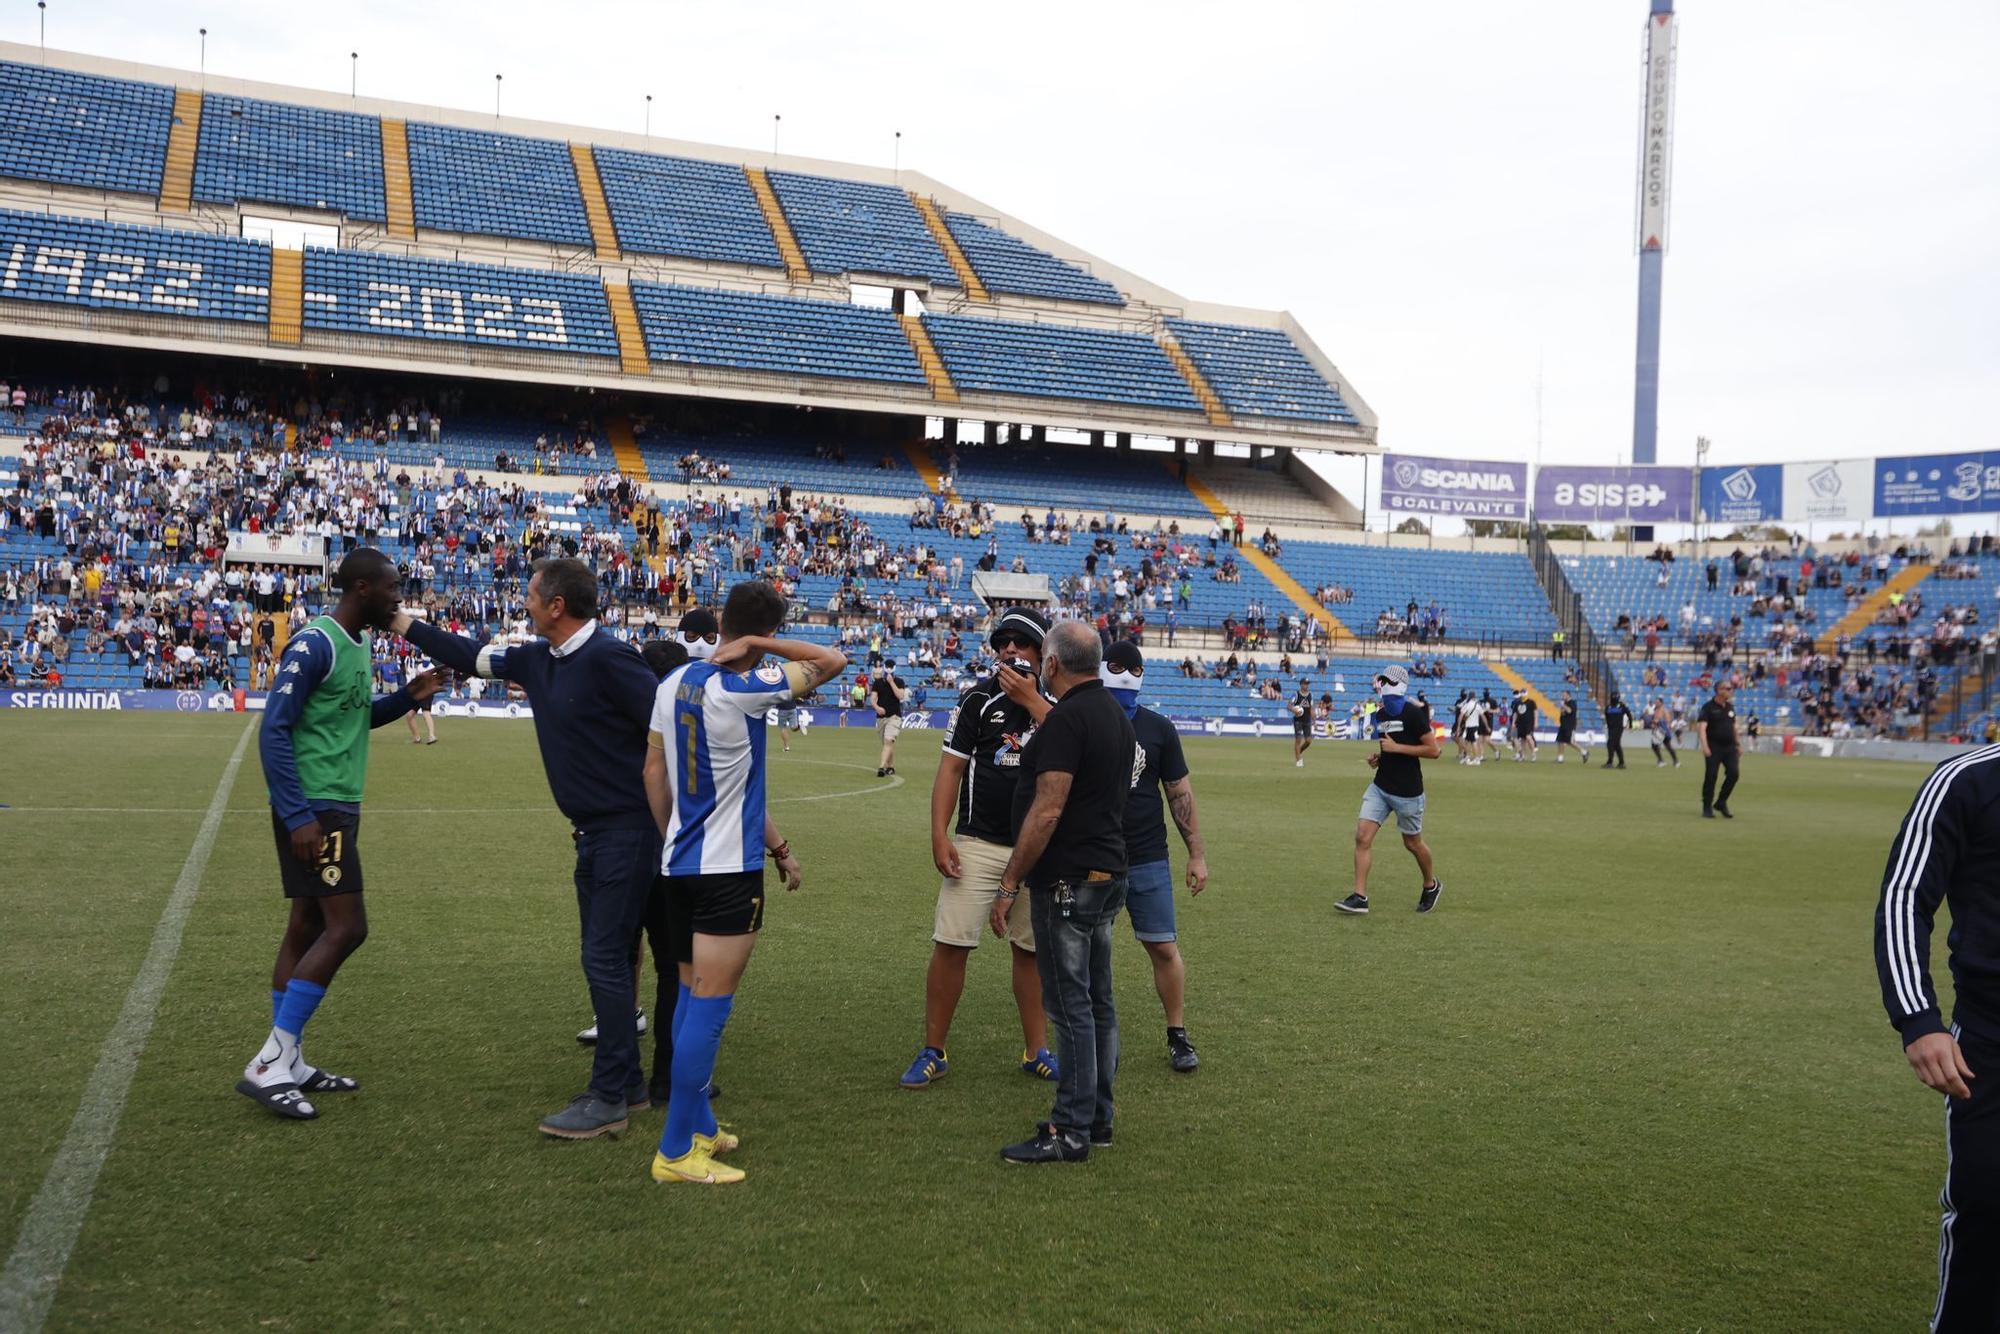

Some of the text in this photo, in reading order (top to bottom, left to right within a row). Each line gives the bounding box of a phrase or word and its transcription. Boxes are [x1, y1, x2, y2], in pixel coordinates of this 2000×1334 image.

[1649, 57, 1666, 206] GRUPO MARCOS
[3, 243, 202, 308] 1922
[366, 282, 568, 343] 2023
[1420, 468, 1515, 492] SCANIA
[1391, 496, 1515, 514] SCALEVANTE
[11, 691, 122, 710] SEGUNDA
